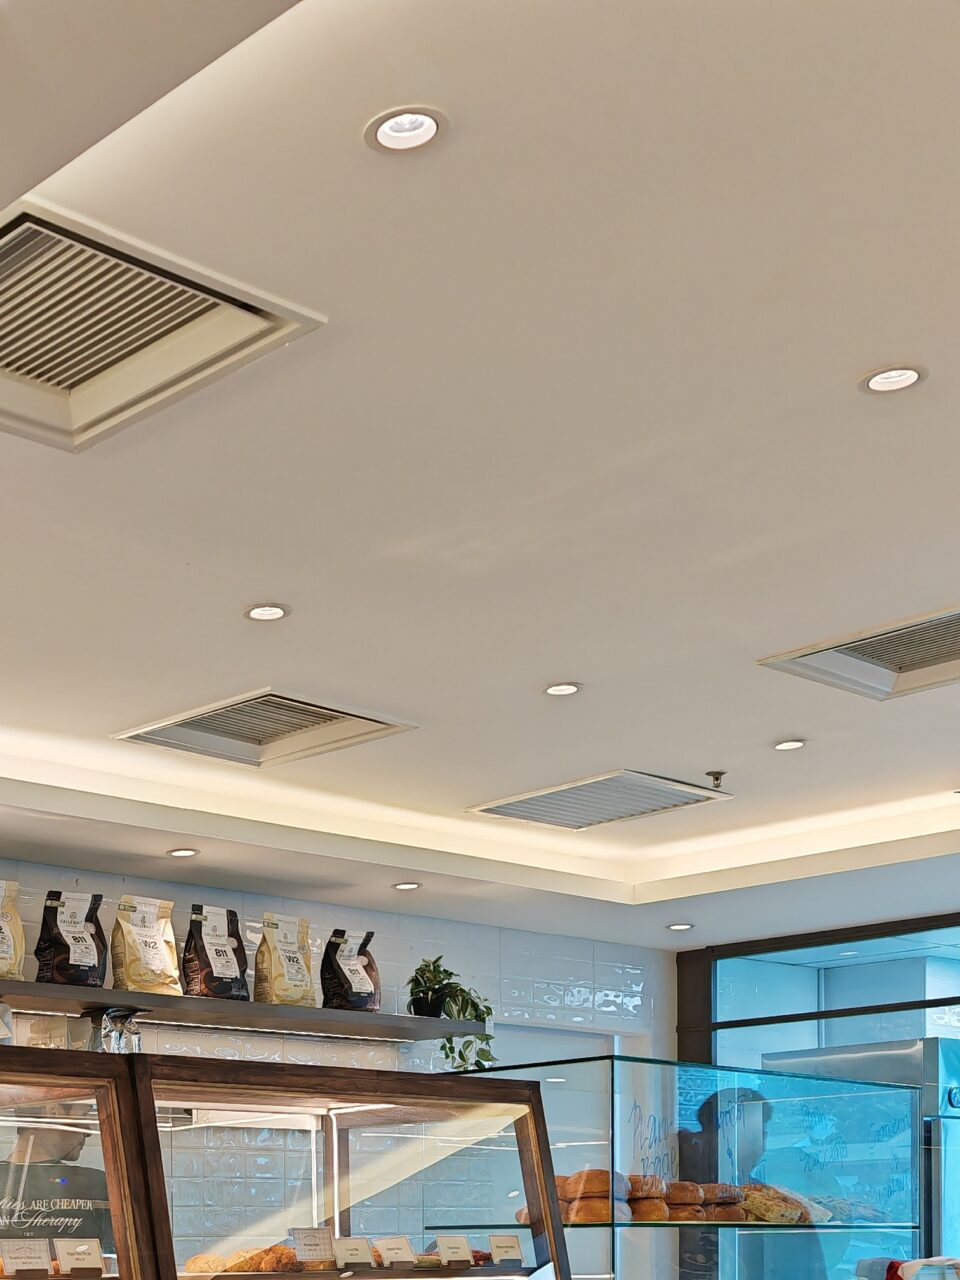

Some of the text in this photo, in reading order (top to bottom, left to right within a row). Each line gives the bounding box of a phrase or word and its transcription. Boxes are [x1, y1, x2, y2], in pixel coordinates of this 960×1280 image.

[71, 935, 87, 943] 811
[141, 939, 159, 950] W2
[214, 948, 229, 958] 811
[285, 954, 302, 964] W2
[30, 1200, 50, 1210] ARE
[50, 1199, 93, 1210] CHEAPER
[12, 1208, 83, 1233] Therapy
